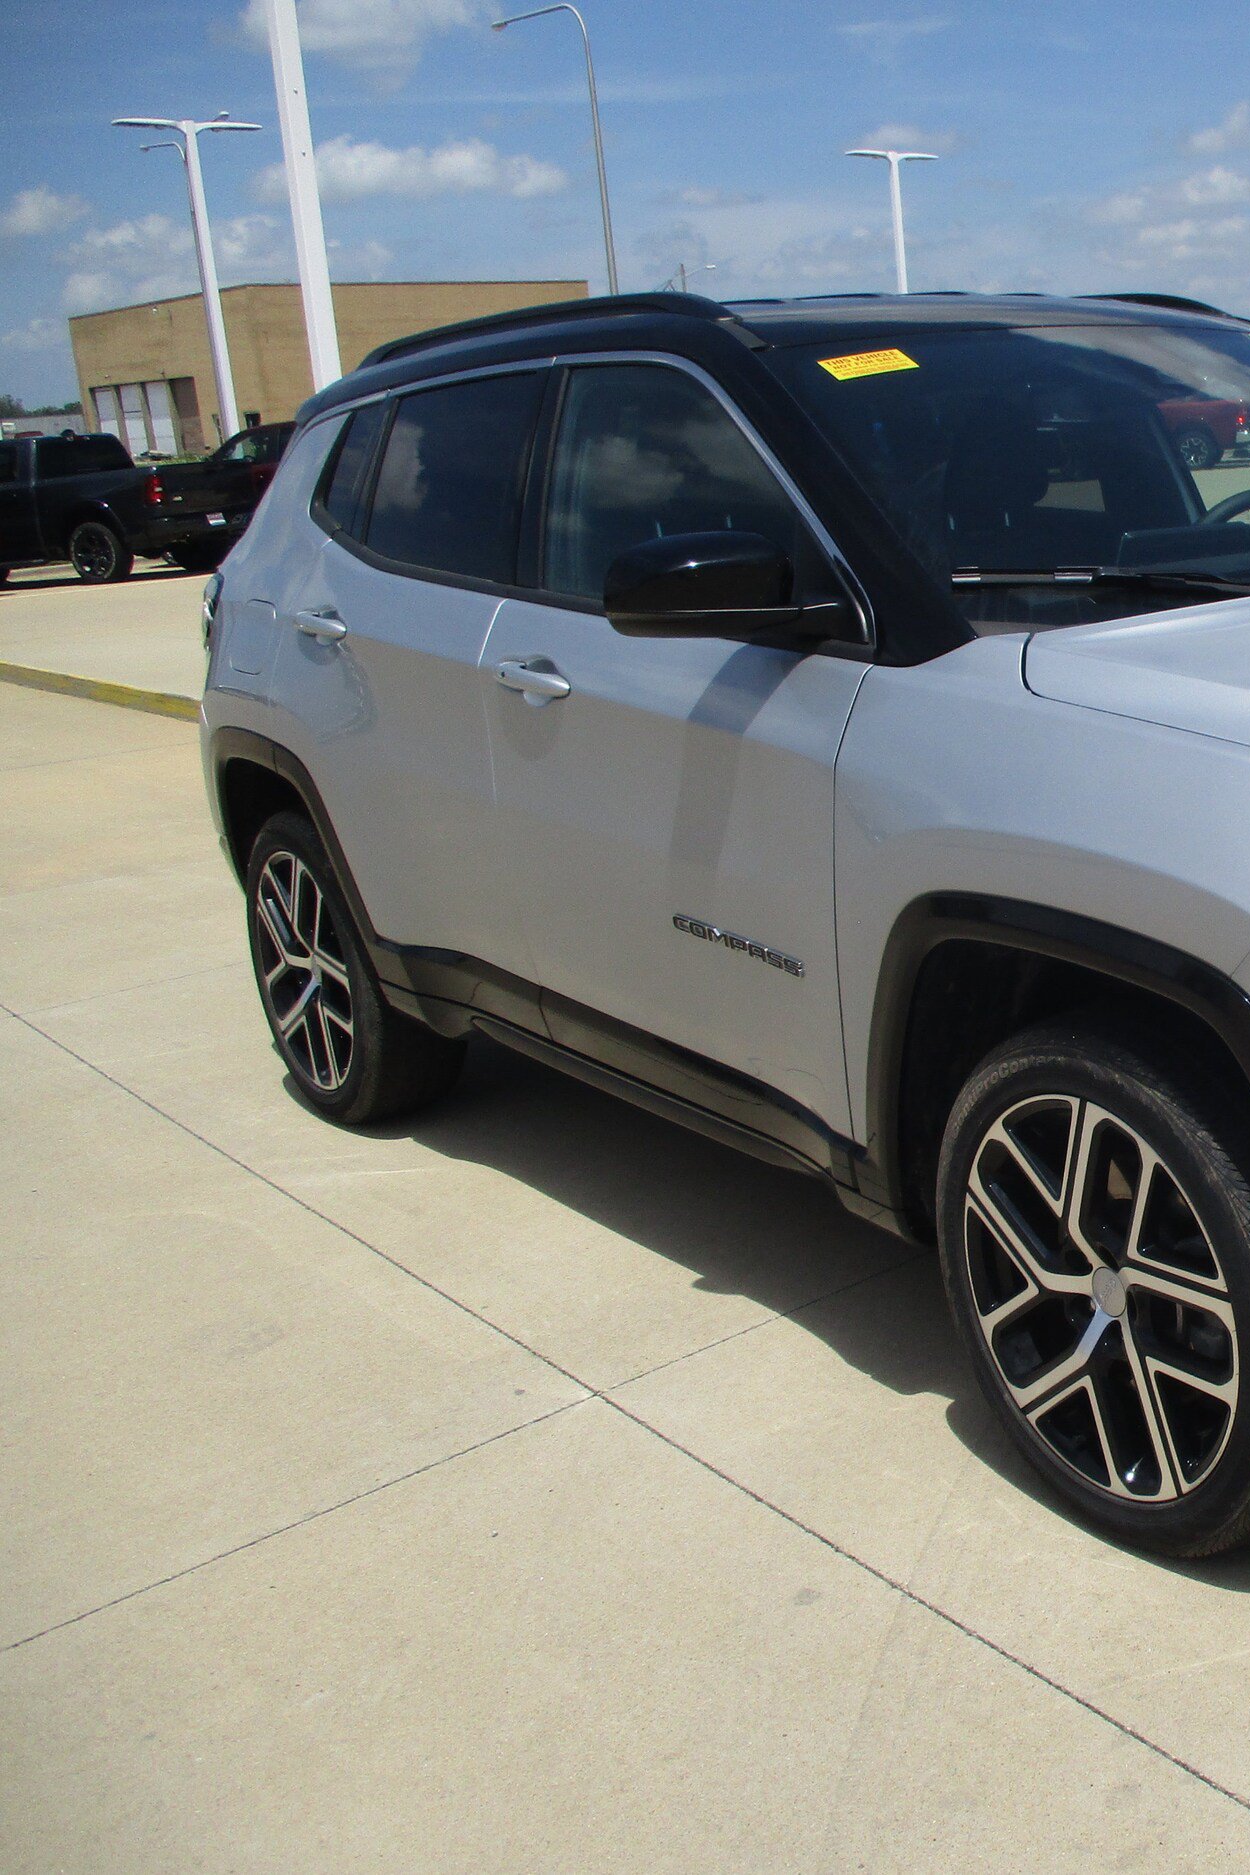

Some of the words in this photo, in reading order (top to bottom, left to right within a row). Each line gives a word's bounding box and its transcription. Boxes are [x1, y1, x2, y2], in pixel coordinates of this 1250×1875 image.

[826, 358, 850, 366] THIS
[853, 351, 897, 361] VEHICLE
[833, 362, 852, 370] NOT
[672, 913, 806, 977] COMPASS
